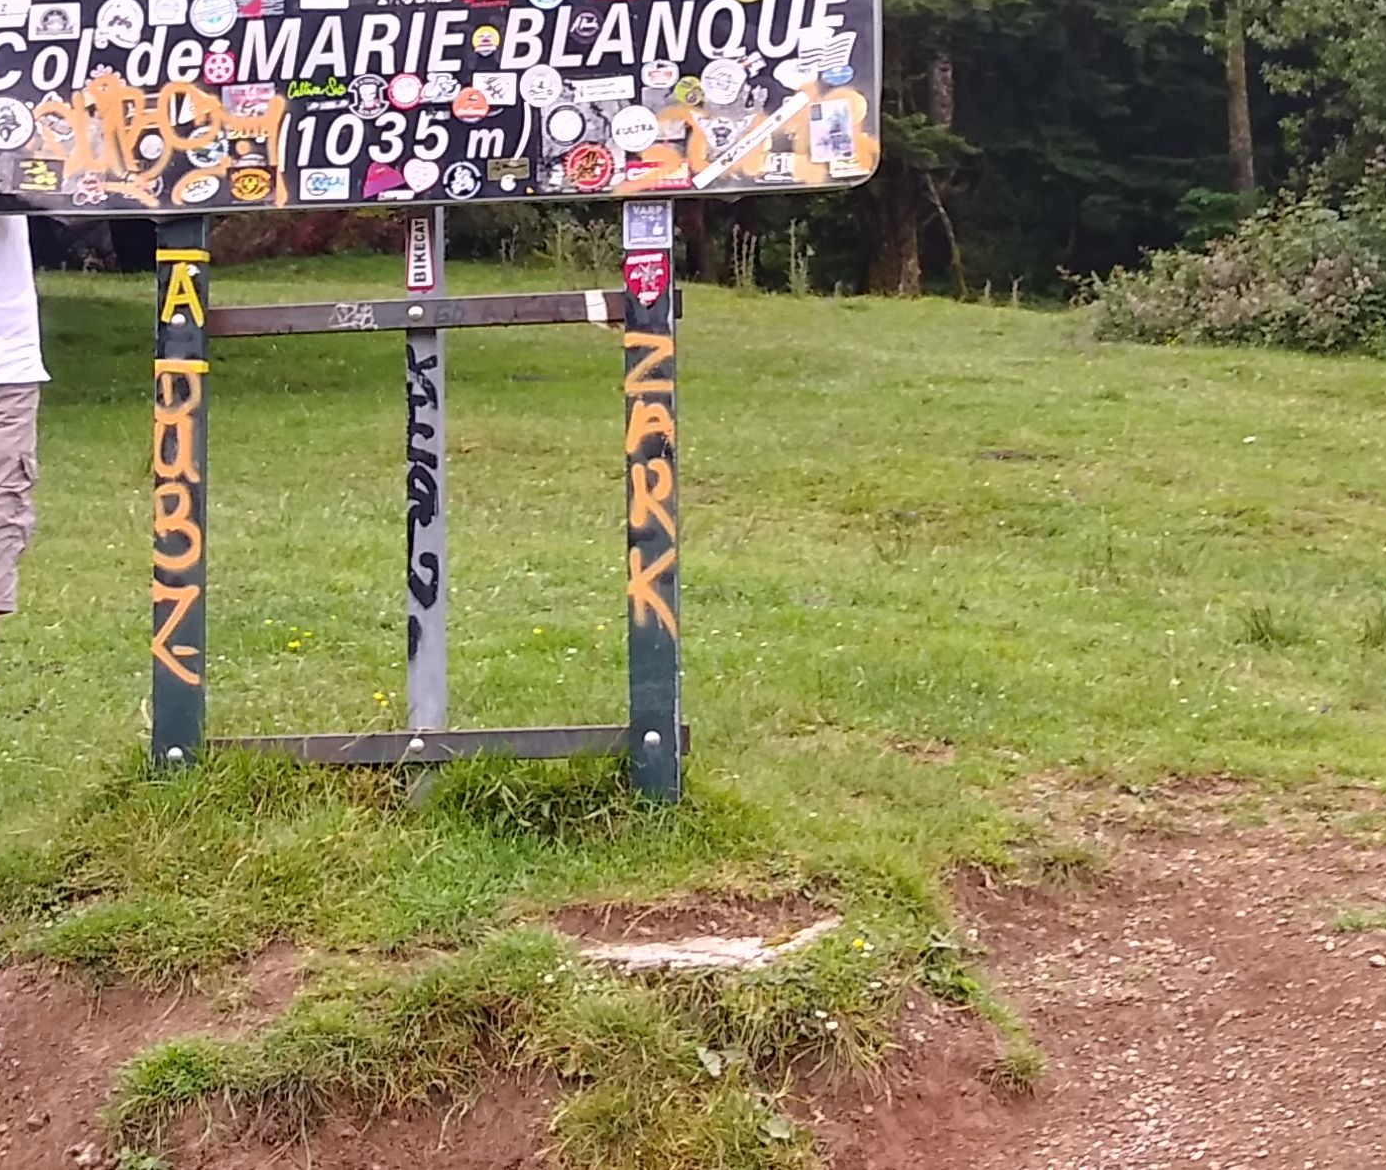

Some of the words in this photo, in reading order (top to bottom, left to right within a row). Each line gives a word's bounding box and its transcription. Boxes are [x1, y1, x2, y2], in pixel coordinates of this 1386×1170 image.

[125, 26, 204, 87] de
[237, 9, 469, 81] MARIE
[466, 101, 533, 162] m)
[413, 219, 427, 283] BIKECAT
